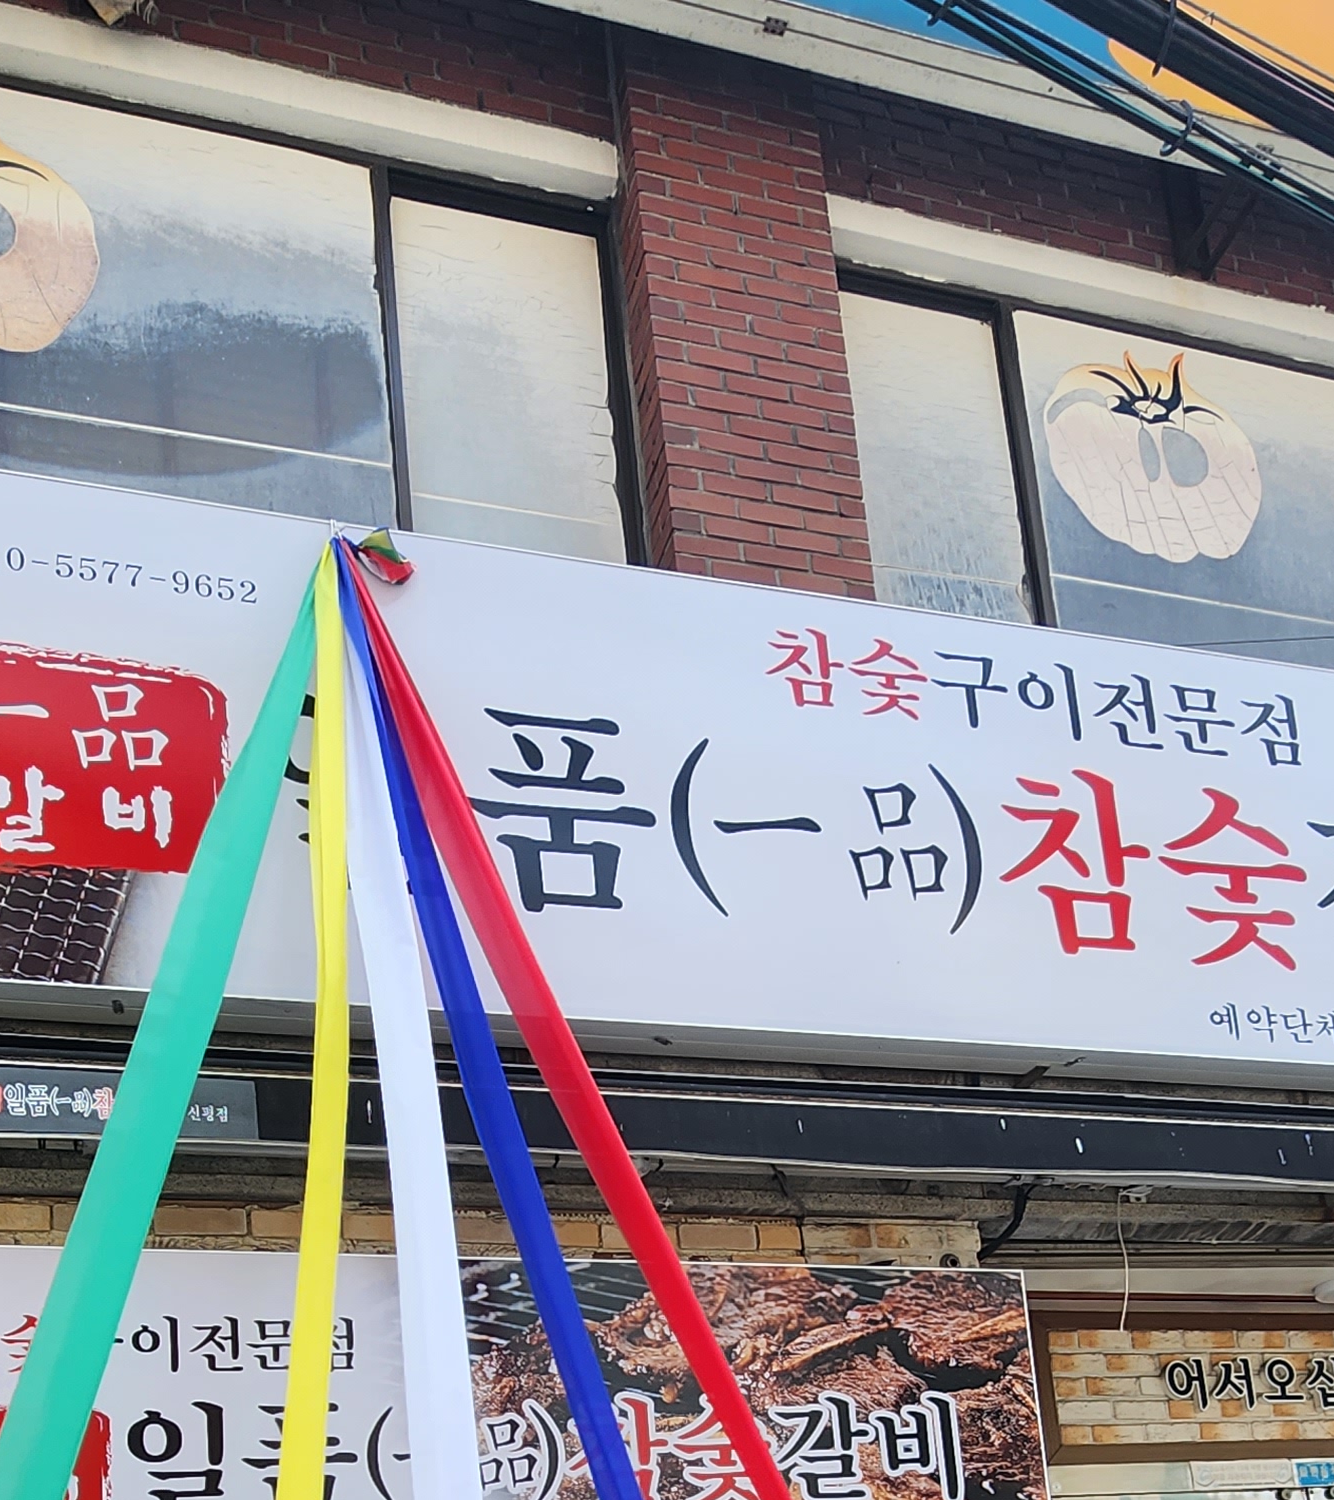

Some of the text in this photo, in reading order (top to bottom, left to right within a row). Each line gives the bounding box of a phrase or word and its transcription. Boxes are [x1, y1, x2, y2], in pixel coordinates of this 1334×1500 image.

[765, 629, 1304, 767] 참숯구이전문점
[3, 1082, 229, 1123] 일품(一品)참 신평점
